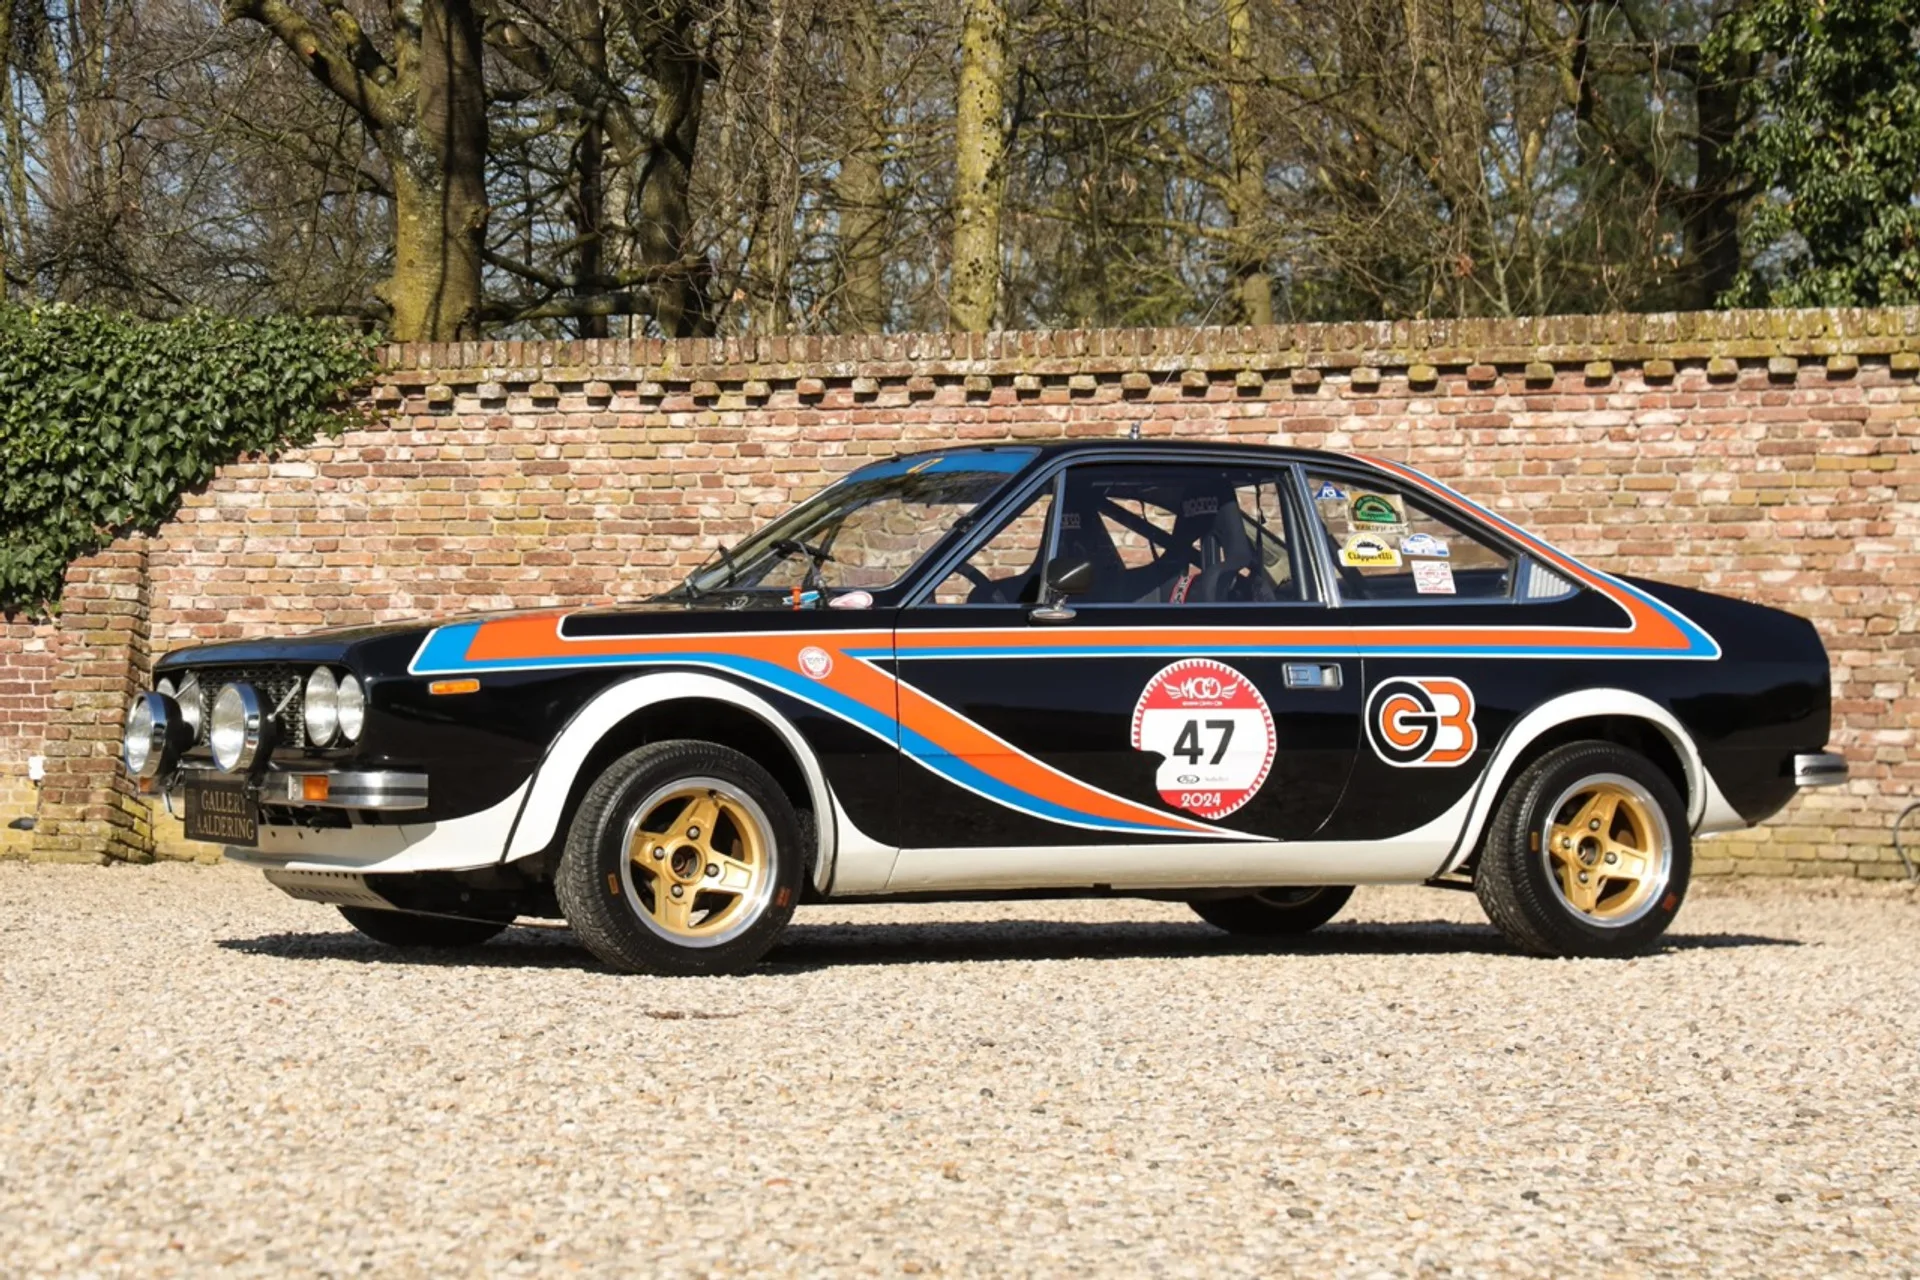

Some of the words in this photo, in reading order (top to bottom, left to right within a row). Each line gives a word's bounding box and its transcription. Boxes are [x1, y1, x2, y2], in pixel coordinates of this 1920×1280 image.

[1172, 719, 1235, 765] 47
[201, 790, 246, 814] GALLERY
[1180, 792, 1221, 807] 2024
[195, 814, 254, 840] AALDERING
